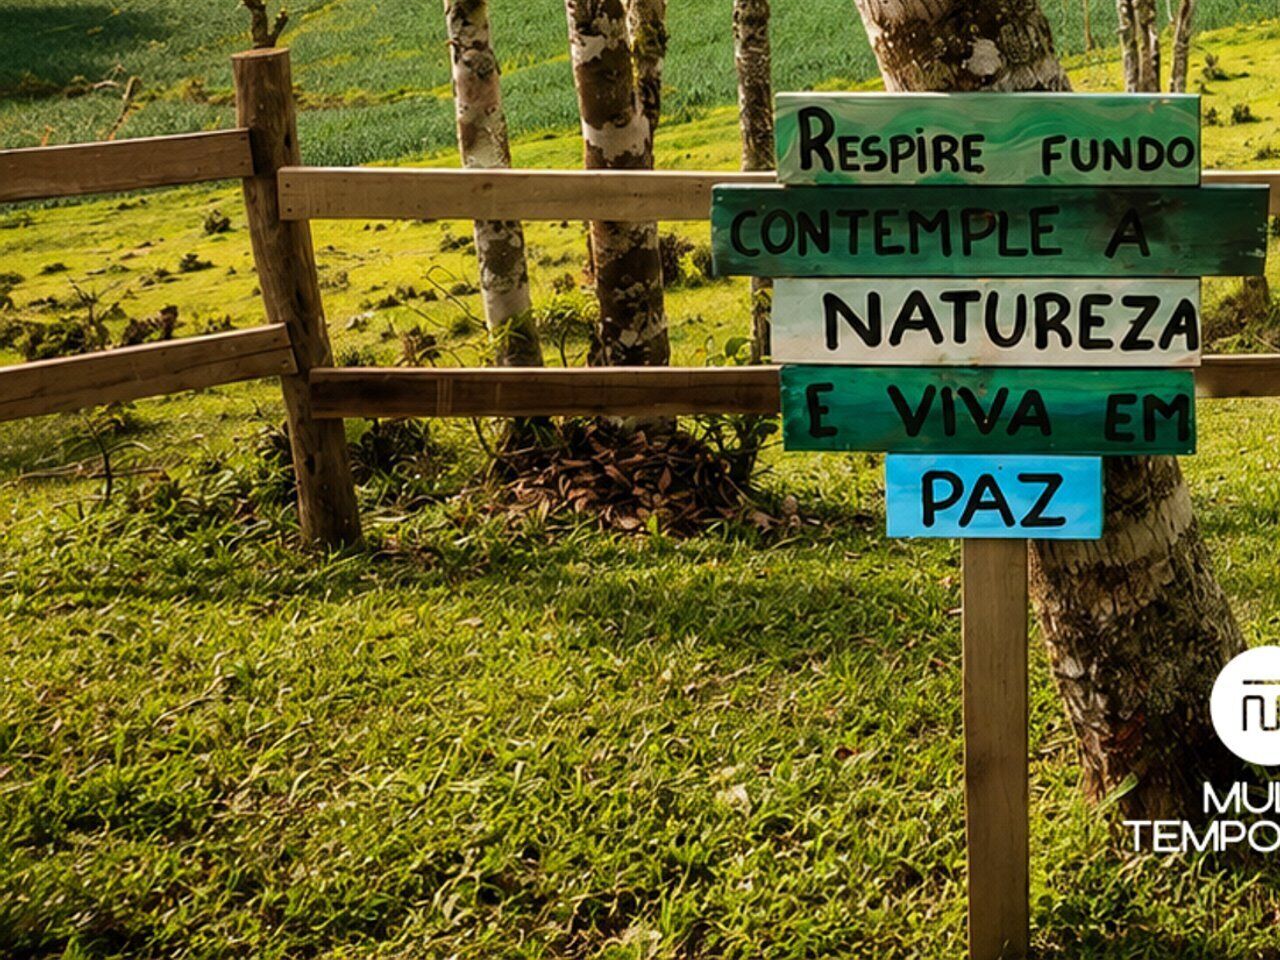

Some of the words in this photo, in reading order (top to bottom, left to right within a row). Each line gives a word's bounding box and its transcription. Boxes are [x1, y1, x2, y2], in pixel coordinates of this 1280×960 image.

[1041, 134, 1196, 175] FUNDO
[729, 205, 1064, 258] CONTEMPLE
[1104, 208, 1151, 259] A
[823, 289, 1200, 351] NATUREZA
[806, 382, 838, 438] E
[886, 385, 1052, 438] VIVA
[1105, 393, 1190, 441] EM
[922, 470, 1067, 528] PAZ
